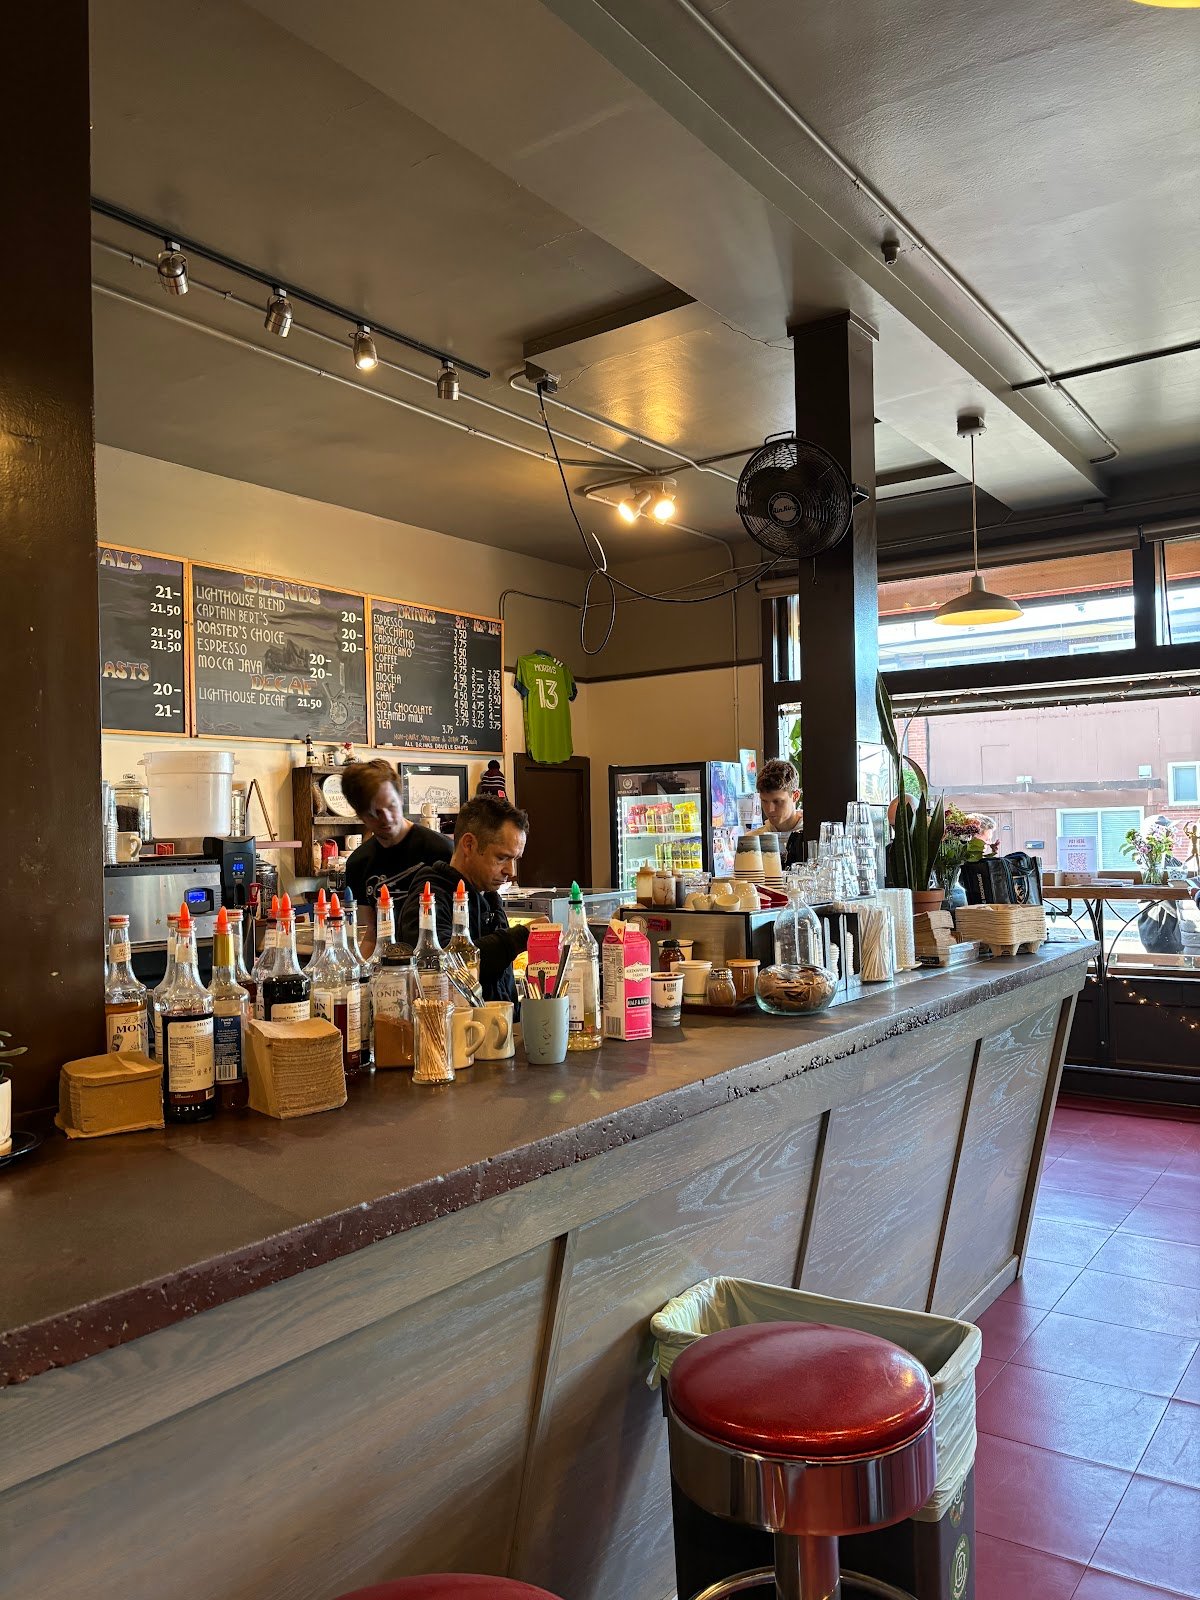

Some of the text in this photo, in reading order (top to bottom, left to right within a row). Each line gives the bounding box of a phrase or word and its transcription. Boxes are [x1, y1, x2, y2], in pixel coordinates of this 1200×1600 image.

[155, 585, 181, 599] 21-
[243, 575, 321, 605] BLENDS
[150, 602, 181, 616] 21.50
[196, 585, 363, 623] LIGHTHOUSE BLEND 20-
[196, 604, 363, 640] CAPTAIN BERT'S 20-
[397, 605, 437, 625] DRINKS
[150, 627, 181, 640] 21.50
[196, 621, 363, 653] ROASTER'S CHOICE 20-
[373, 614, 467, 640] ESPRESSO 3.50
[373, 624, 467, 649] MACCHIATO 3.75
[150, 639, 181, 652] 21.50
[197, 638, 332, 666] ESPRESSO 20-
[373, 634, 467, 658] CAPPUCCINO 4.50
[374, 643, 467, 666] AMERICANO 3.50
[198, 655, 333, 679] MOCCA JAVA 20-
[374, 653, 399, 665] COFFEE
[453, 665, 467, 675] 2.75
[375, 661, 395, 674] LATTE
[534, 663, 557, 674] MORRIS
[153, 683, 181, 696] 20-
[250, 673, 318, 695] DECAF
[375, 671, 402, 684] MOCHA
[471, 683, 485, 694] 5.25
[375, 682, 396, 693] BREVE
[453, 691, 468, 701] 4.50
[198, 687, 322, 709] LIGHTHOUSE DECAF 21.50
[375, 691, 392, 701] CHAI
[454, 700, 469, 709] 4.50
[471, 701, 485, 711] 4.75
[535, 678, 559, 710] 13
[154, 704, 181, 717] 21-
[376, 701, 392, 711] HOT
[394, 702, 433, 716] CHOCOLATE
[454, 708, 469, 718] 3.50
[471, 710, 485, 719] 3.75
[376, 710, 502, 730] STEAMED MILK 2.75 3.25 3.75
[377, 719, 454, 735] TEA 3.75
[415, 741, 433, 749] DRINKS
[434, 742, 454, 750] DOUBLE
